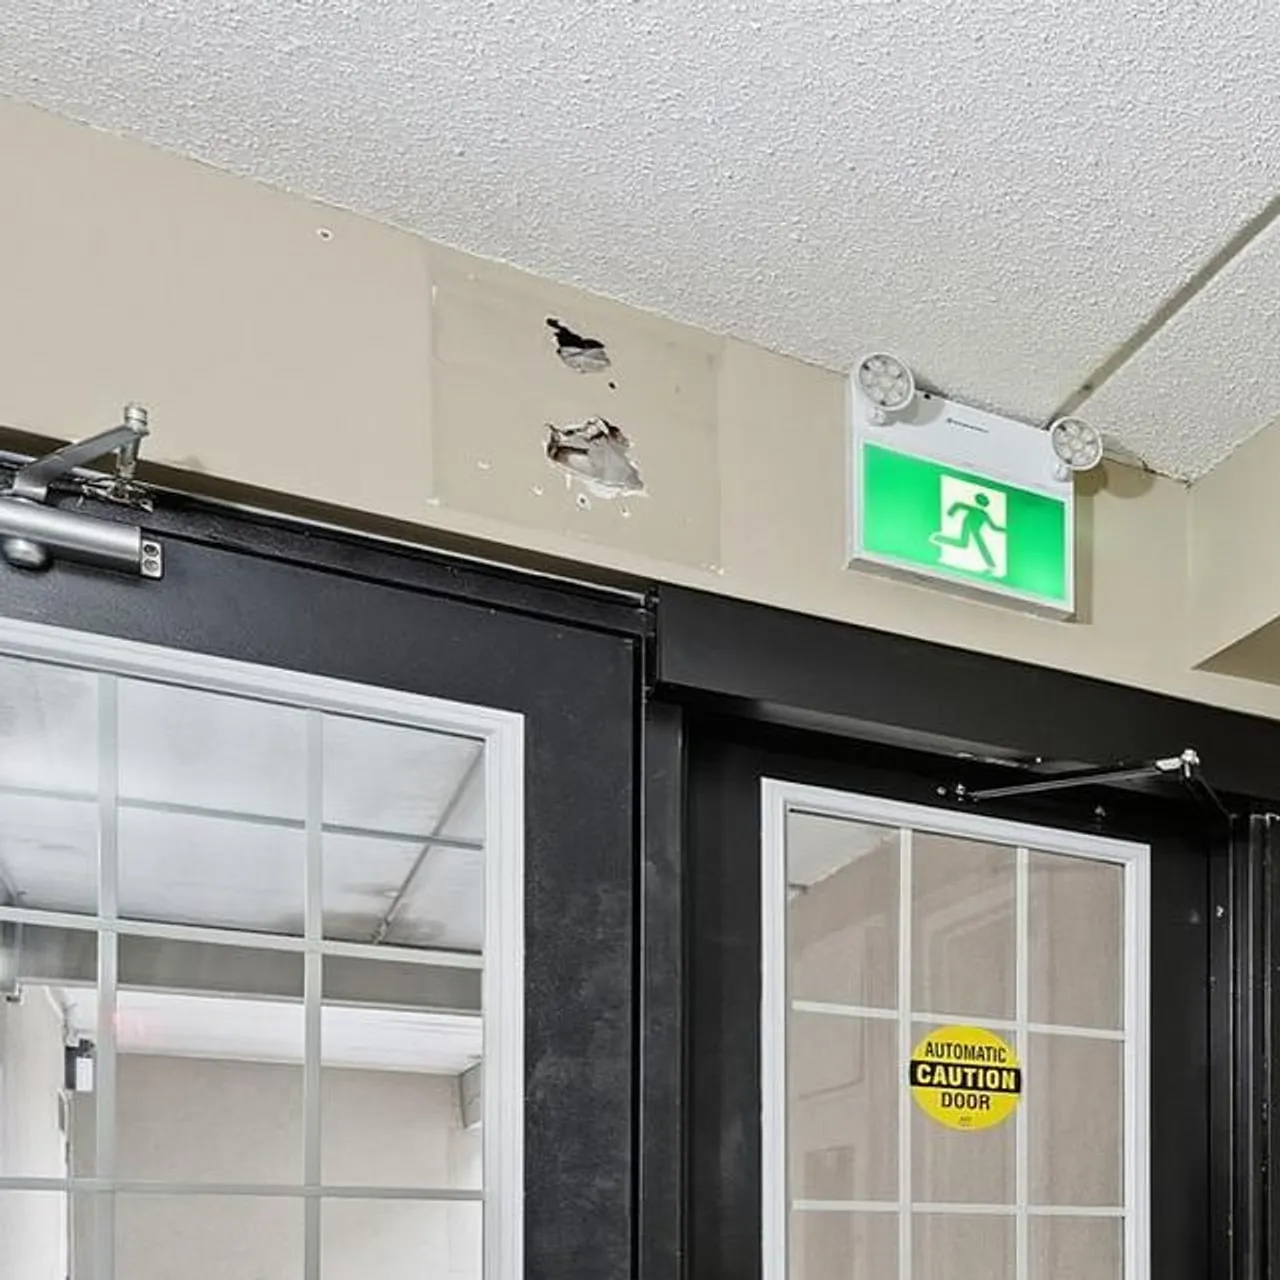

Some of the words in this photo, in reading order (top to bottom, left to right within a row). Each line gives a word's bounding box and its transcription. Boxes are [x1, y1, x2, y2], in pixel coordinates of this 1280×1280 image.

[925, 1041, 1007, 1063] AUTOMATIC
[916, 1063, 1016, 1090] CAUTION
[941, 1091, 991, 1110] DOOR
